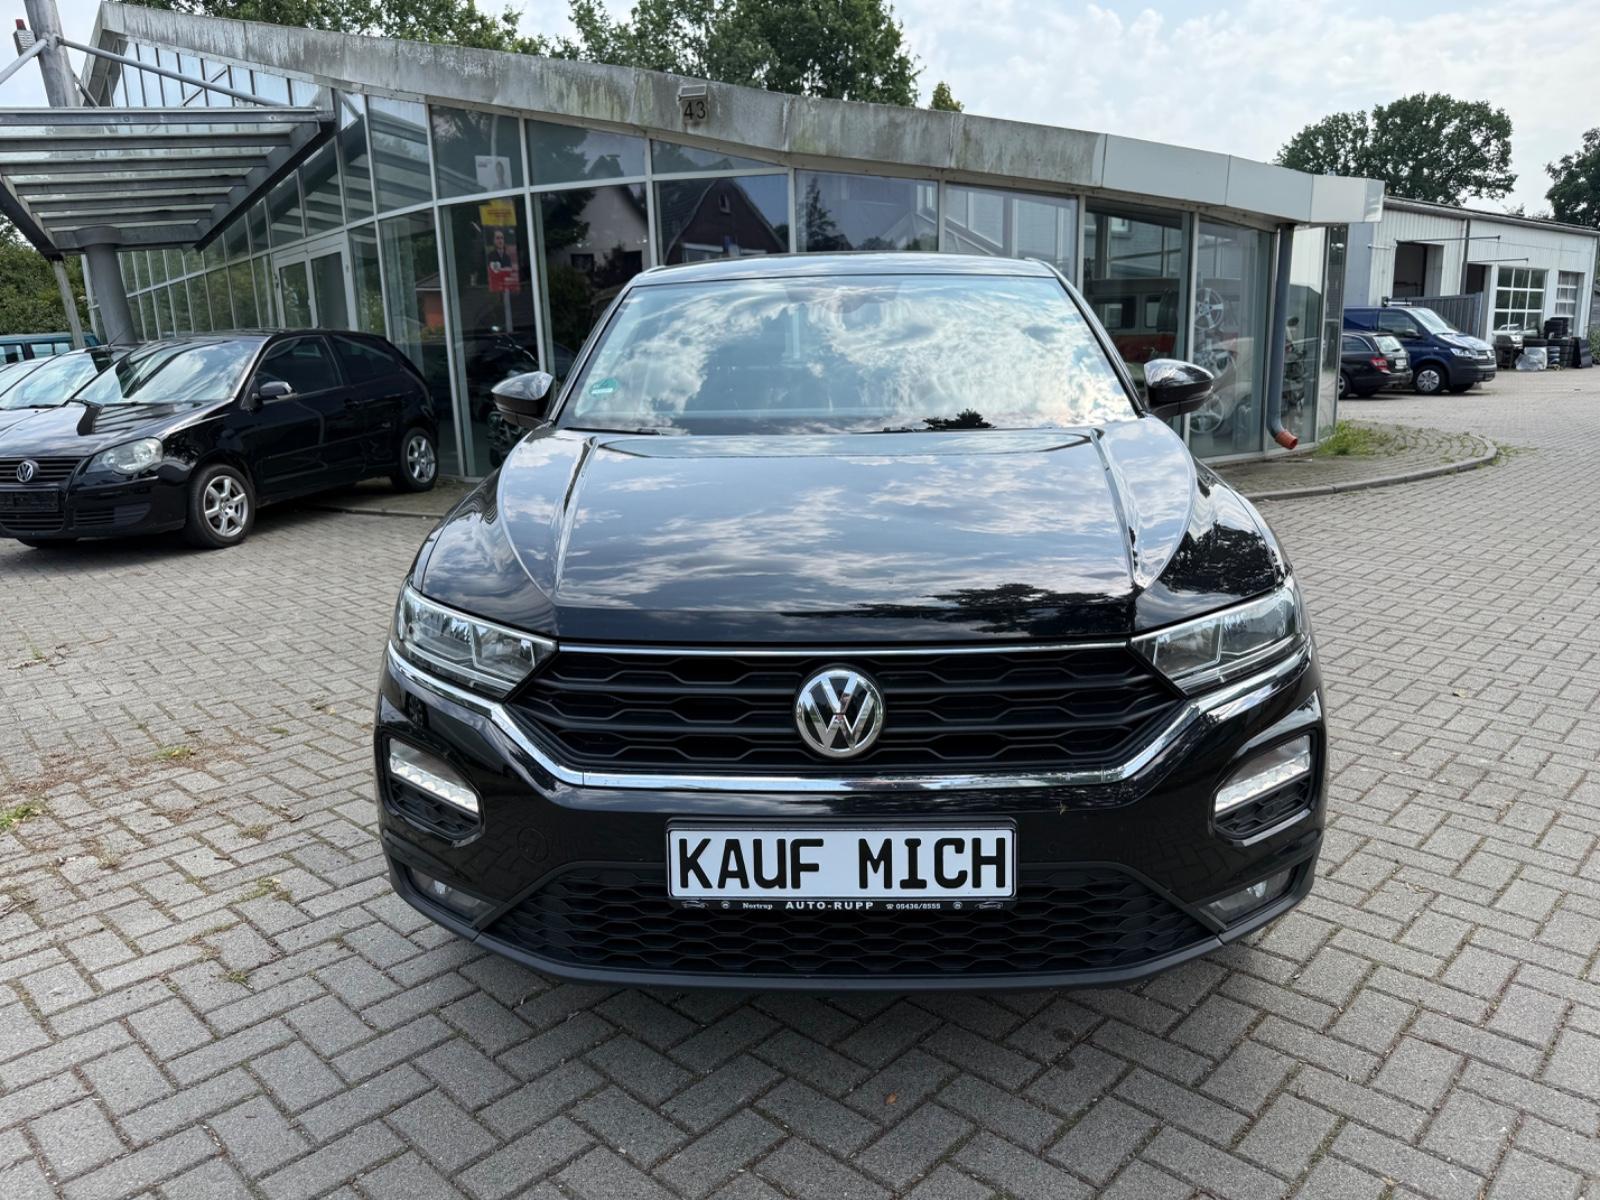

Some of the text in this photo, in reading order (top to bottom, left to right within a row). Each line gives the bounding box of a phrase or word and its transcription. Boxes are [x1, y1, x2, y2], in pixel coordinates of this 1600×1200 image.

[684, 101, 706, 120] 43
[678, 837, 1006, 890] KAUF MICH
[785, 901, 874, 910] AUTO-RUPP
